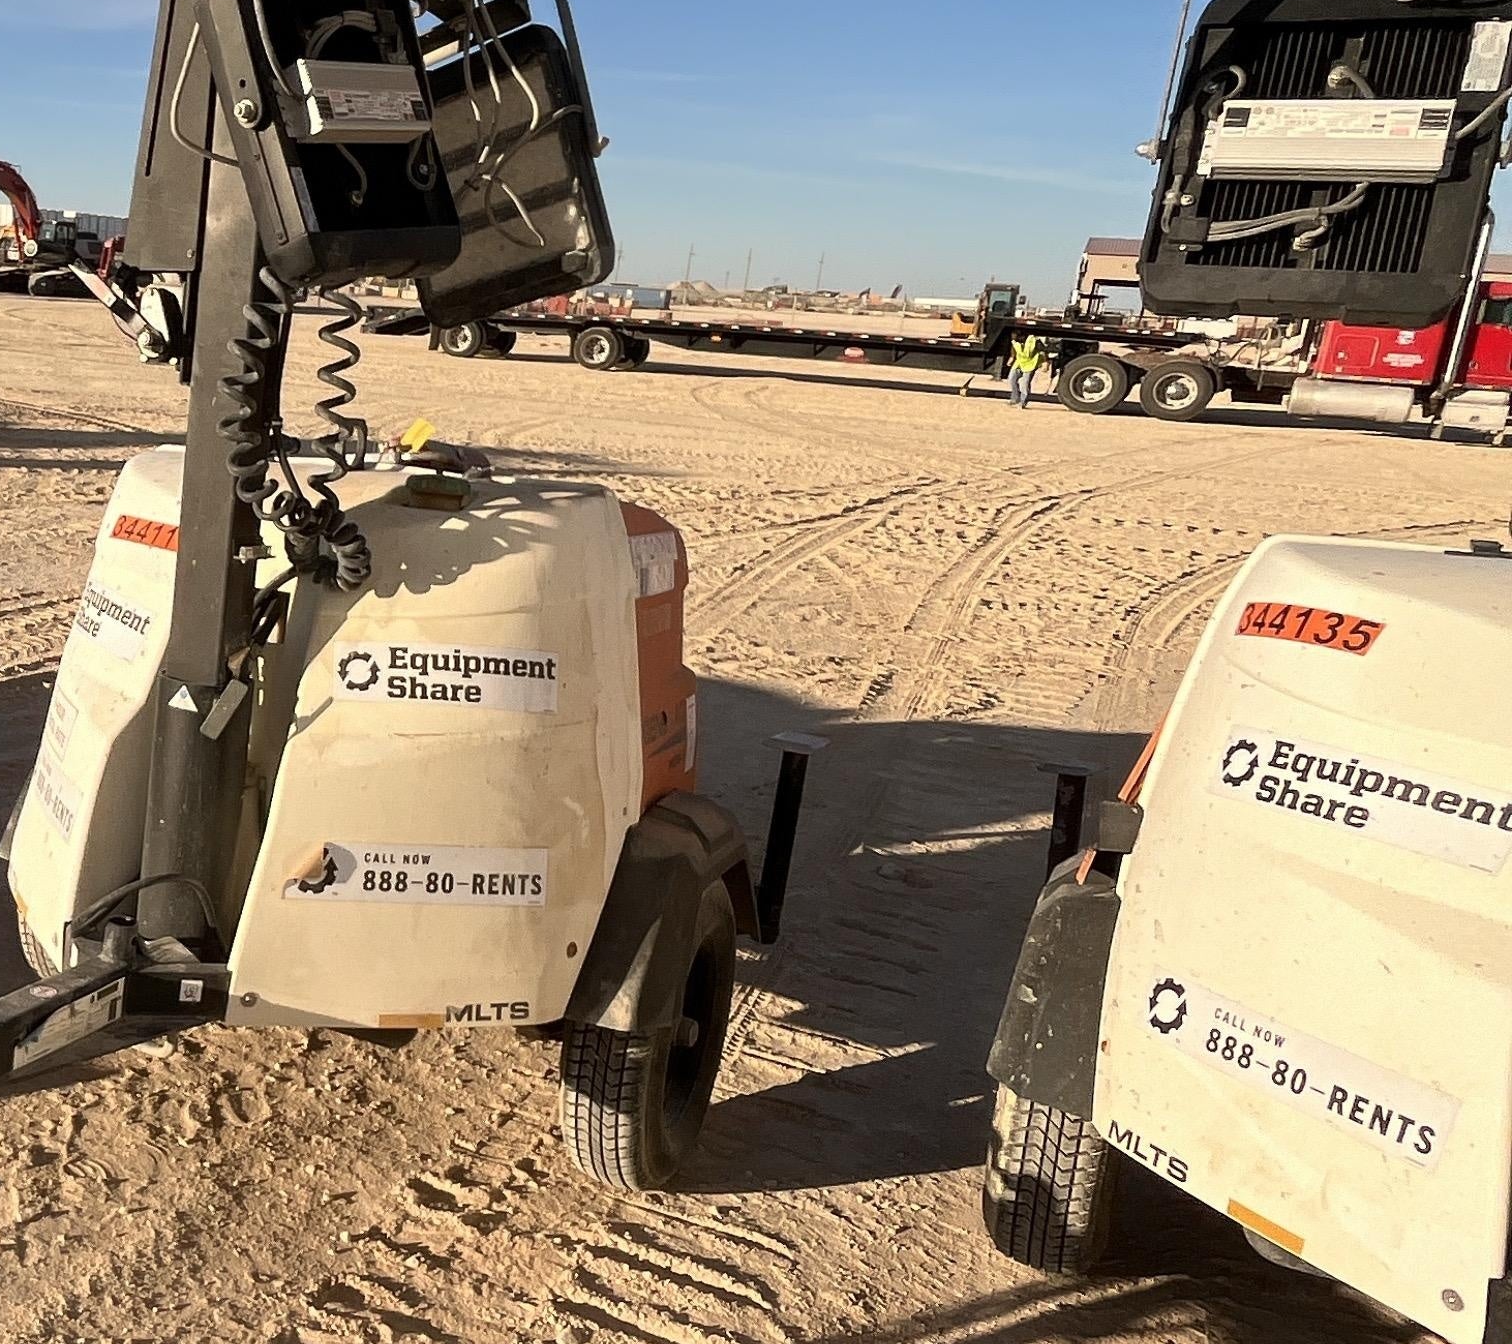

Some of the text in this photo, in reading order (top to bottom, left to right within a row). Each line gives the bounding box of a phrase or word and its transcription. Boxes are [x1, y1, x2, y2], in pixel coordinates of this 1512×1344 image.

[85, 582, 151, 635] quipment
[1239, 603, 1381, 651] 344135
[387, 646, 556, 680] Equipment
[387, 675, 482, 703] Share
[1255, 775, 1370, 828] Share
[1268, 740, 1512, 832] Equipment
[364, 852, 431, 865] CALL NOW
[362, 870, 542, 896] 888-80-RENTS
[445, 1001, 530, 1023] MLTS
[1214, 1008, 1287, 1048] CALL NOW
[1205, 1028, 1436, 1155] 888-80-RENTS
[1108, 1119, 1189, 1183] MLTS
